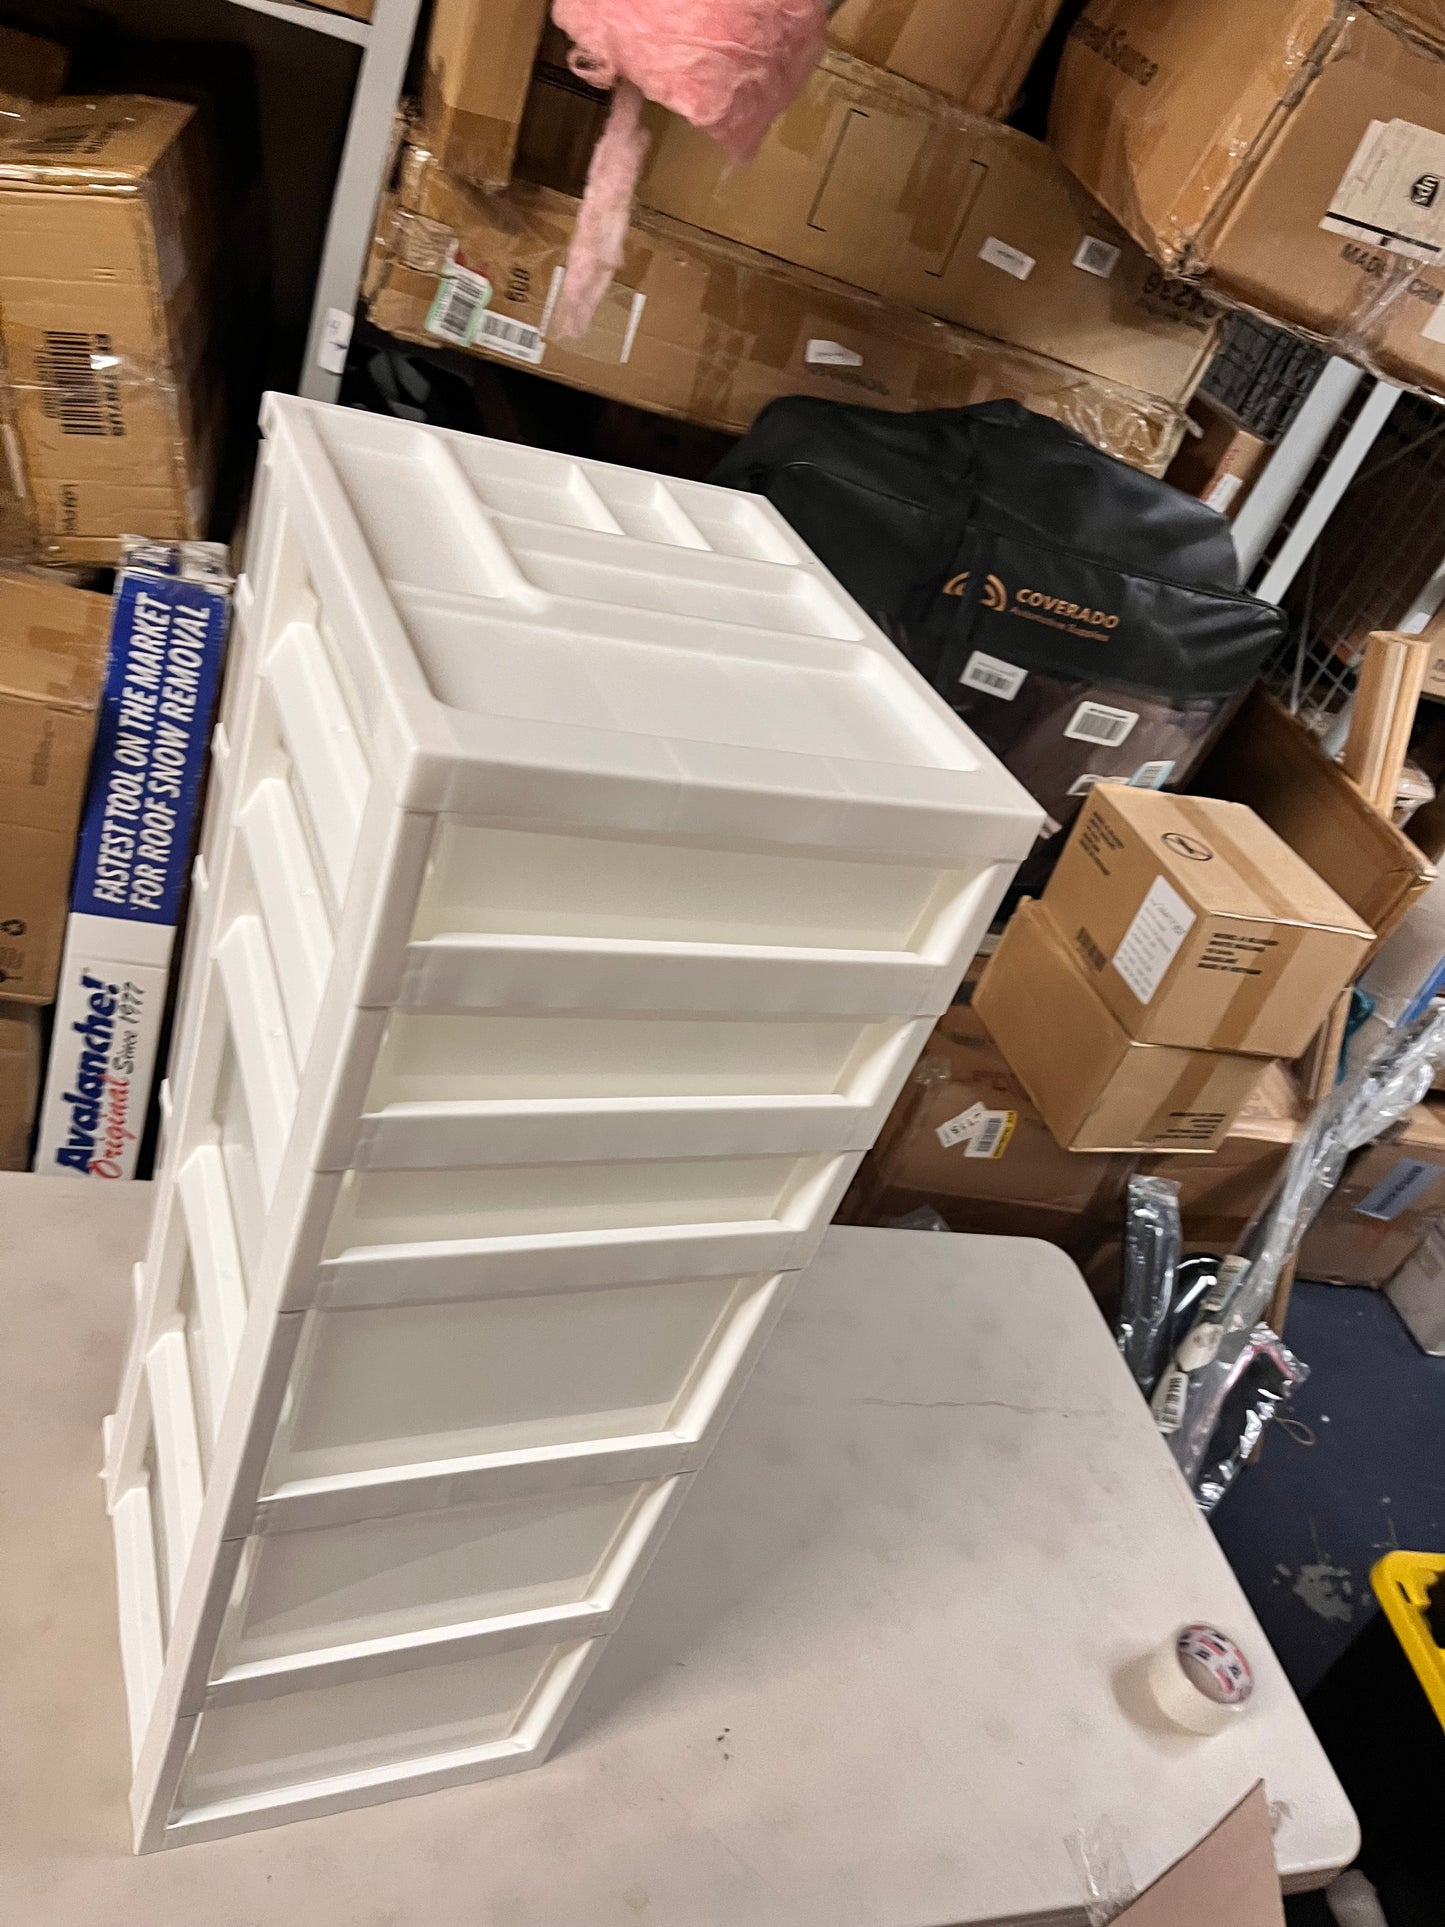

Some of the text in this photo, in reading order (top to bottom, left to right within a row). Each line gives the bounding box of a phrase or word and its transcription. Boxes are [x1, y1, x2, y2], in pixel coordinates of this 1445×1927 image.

[124, 592, 172, 690] MARKET
[1015, 588, 1120, 629] COVERADO
[113, 731, 150, 767] ON
[118, 687, 158, 731] THE
[104, 770, 146, 820] TOOL
[129, 605, 210, 909] FOR ROOF SNOW REMOVAL
[92, 819, 137, 904] FASTEST
[55, 975, 119, 1175] Avalanche!
[89, 1073, 137, 1179] Original
